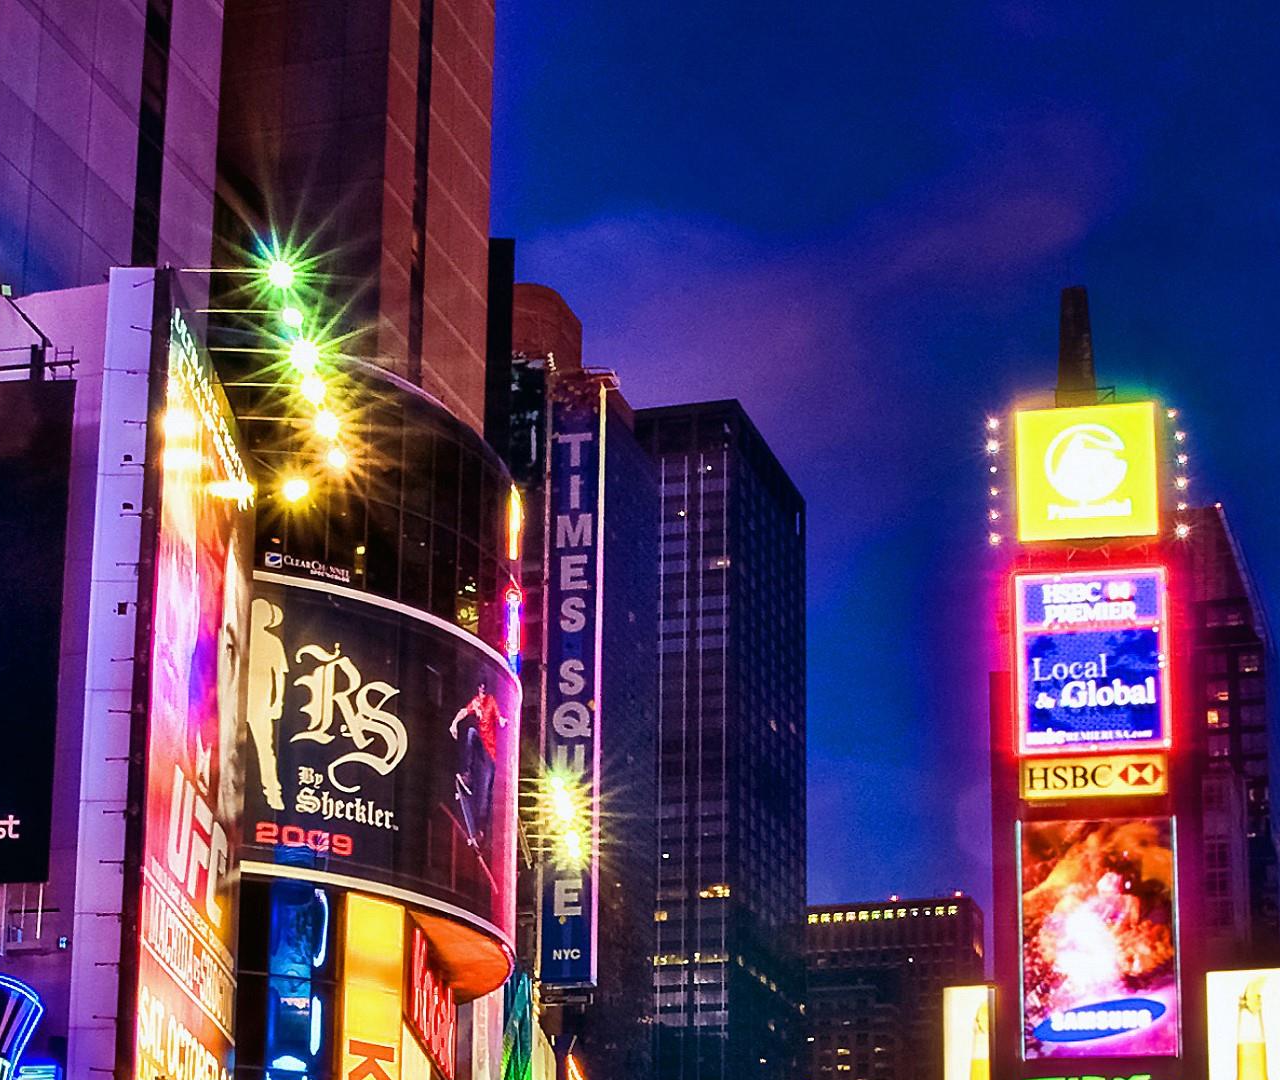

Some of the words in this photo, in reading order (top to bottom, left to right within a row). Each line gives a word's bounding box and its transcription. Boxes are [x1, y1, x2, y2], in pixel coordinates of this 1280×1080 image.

[556, 432, 593, 633] TIMES
[1041, 581, 1102, 604] HSBC
[1043, 600, 1137, 626] PREMIER
[1032, 654, 1108, 682] Local
[1060, 676, 1157, 710] Global
[298, 766, 323, 788] By
[552, 658, 592, 918] SQUE
[1027, 763, 1115, 791] HSBC
[296, 789, 395, 831] Sheckler
[167, 764, 229, 928] UFC
[552, 948, 581, 960] NYC
[1049, 1008, 1153, 1031] SAMSUNG
